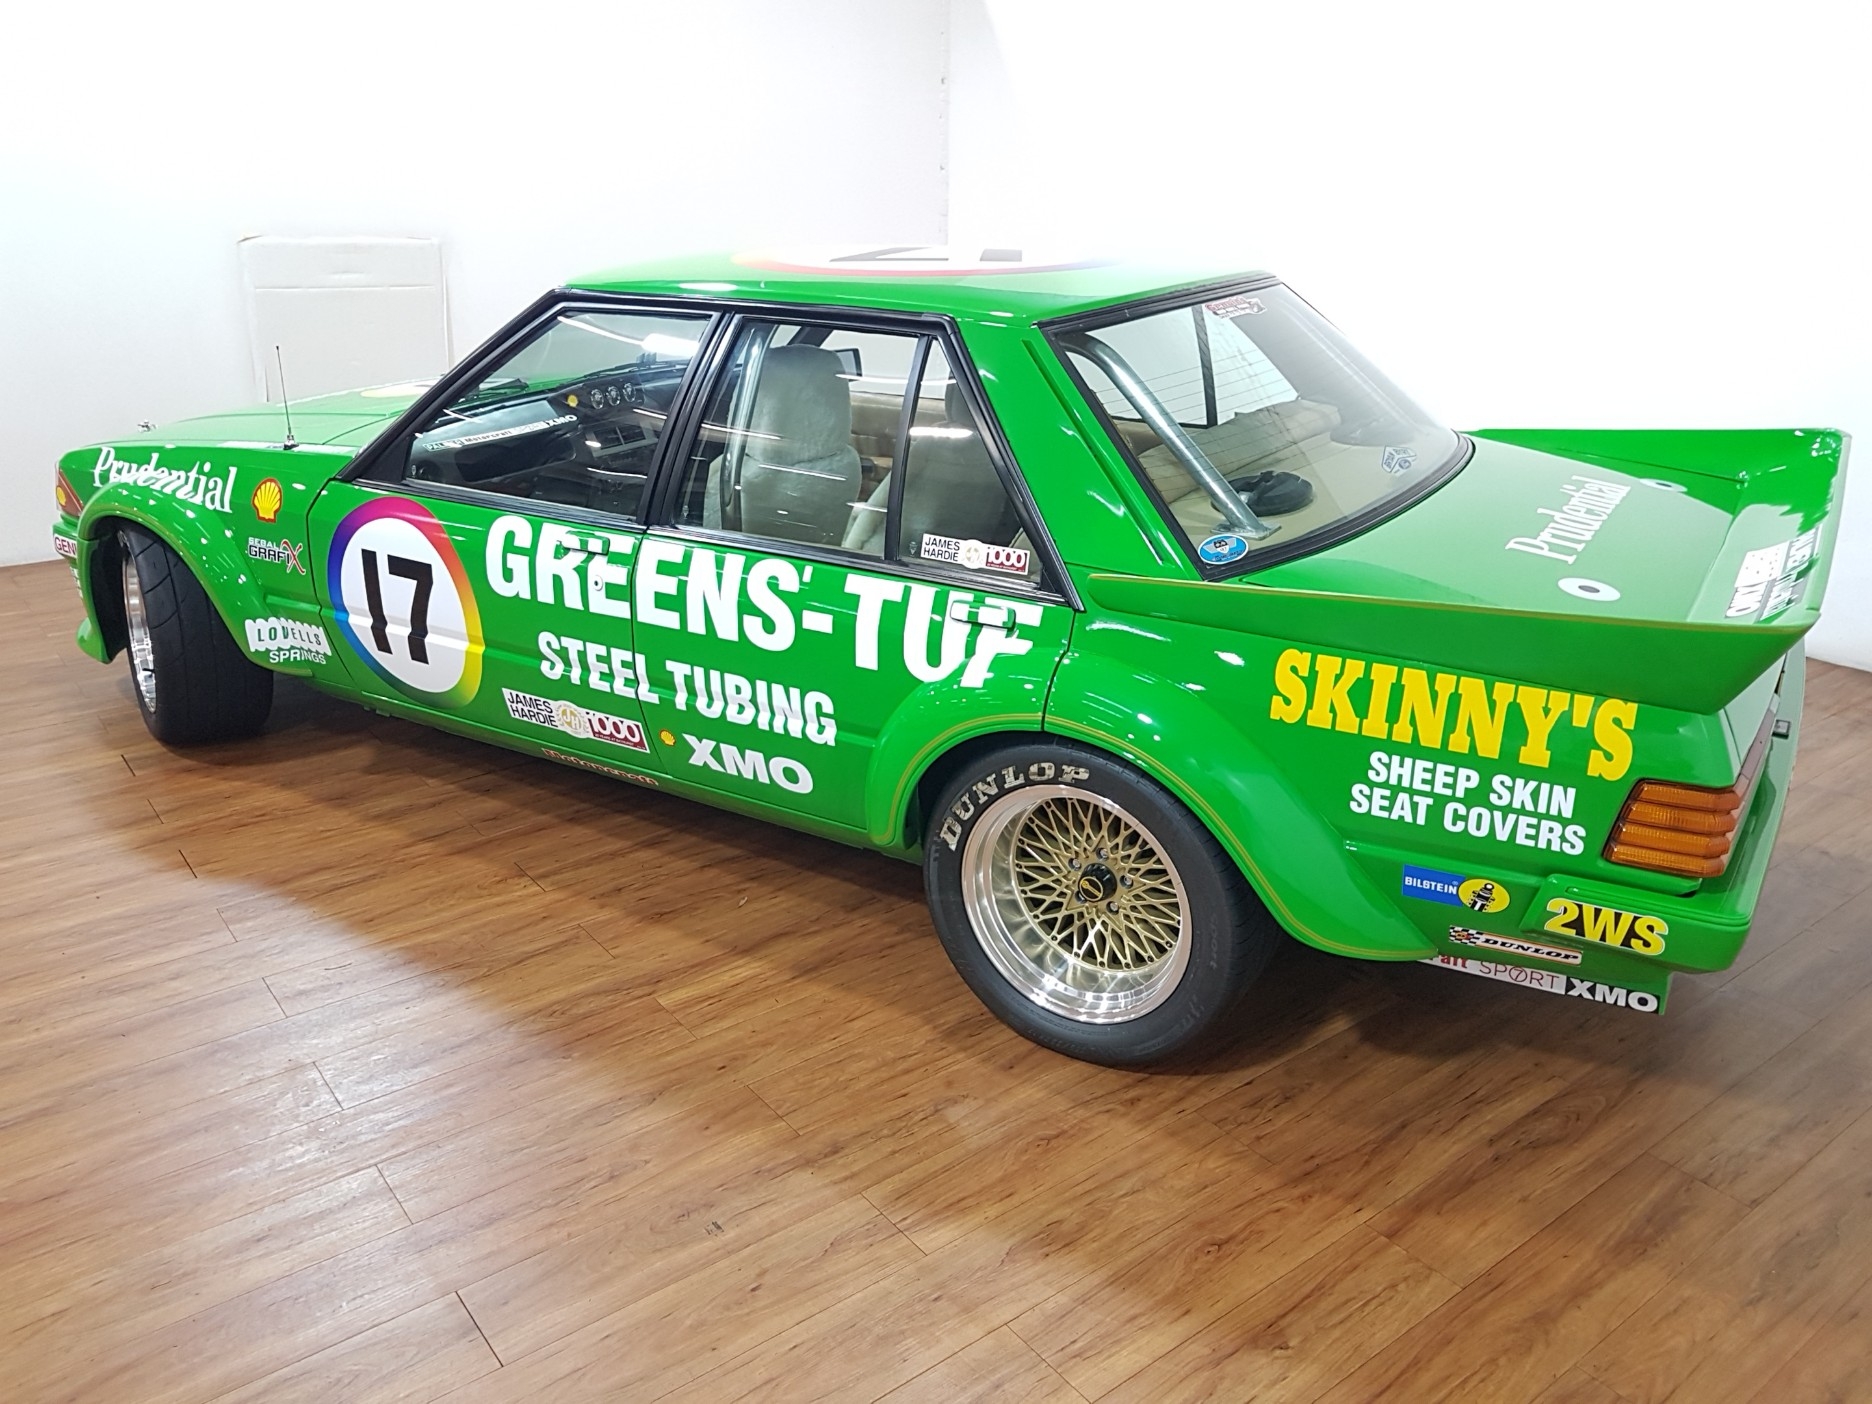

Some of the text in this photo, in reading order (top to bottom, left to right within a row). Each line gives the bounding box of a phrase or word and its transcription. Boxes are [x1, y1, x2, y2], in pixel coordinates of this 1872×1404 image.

[546, 414, 577, 427] XMO
[93, 447, 237, 513] Prudential
[1505, 474, 1631, 565] Prudential
[923, 547, 959, 562] HARDIE
[925, 537, 960, 551] JAMES
[987, 547, 1026, 568] 1000
[361, 548, 434, 665] 17
[257, 626, 322, 646] LOVELLS
[269, 650, 327, 665] SPRINGS
[507, 692, 553, 714] JAMES
[538, 631, 838, 747] STEEL TUBING
[510, 704, 559, 728] HARDIE
[588, 712, 641, 743] 1000
[1270, 648, 1639, 782] SKINNY'S
[682, 733, 814, 795] XMO
[1367, 750, 1577, 819] SHEEP SKIN
[939, 762, 1090, 851] DUNLOP
[1349, 783, 1587, 857] SEAT COVERS
[1404, 875, 1458, 896] BILSTEIN
[1544, 898, 1668, 956] 2WS
[1482, 936, 1580, 961] DUNLOP
[1567, 977, 1659, 1014] XMO
